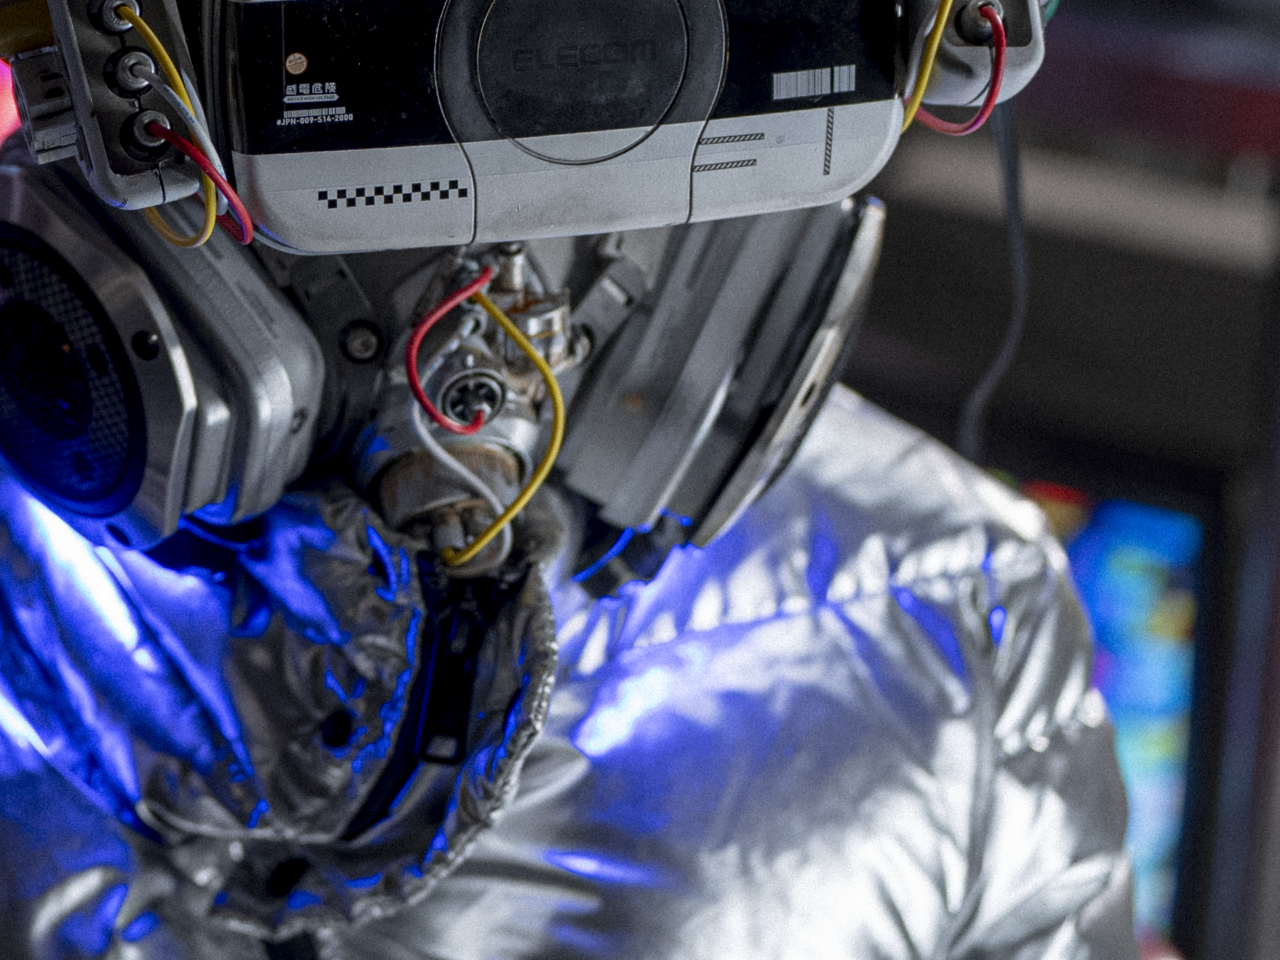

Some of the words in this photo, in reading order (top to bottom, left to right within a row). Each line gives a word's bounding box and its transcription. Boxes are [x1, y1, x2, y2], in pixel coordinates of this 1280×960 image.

[512, 38, 657, 72] ELECOM
[285, 82, 336, 95] 感電危険
